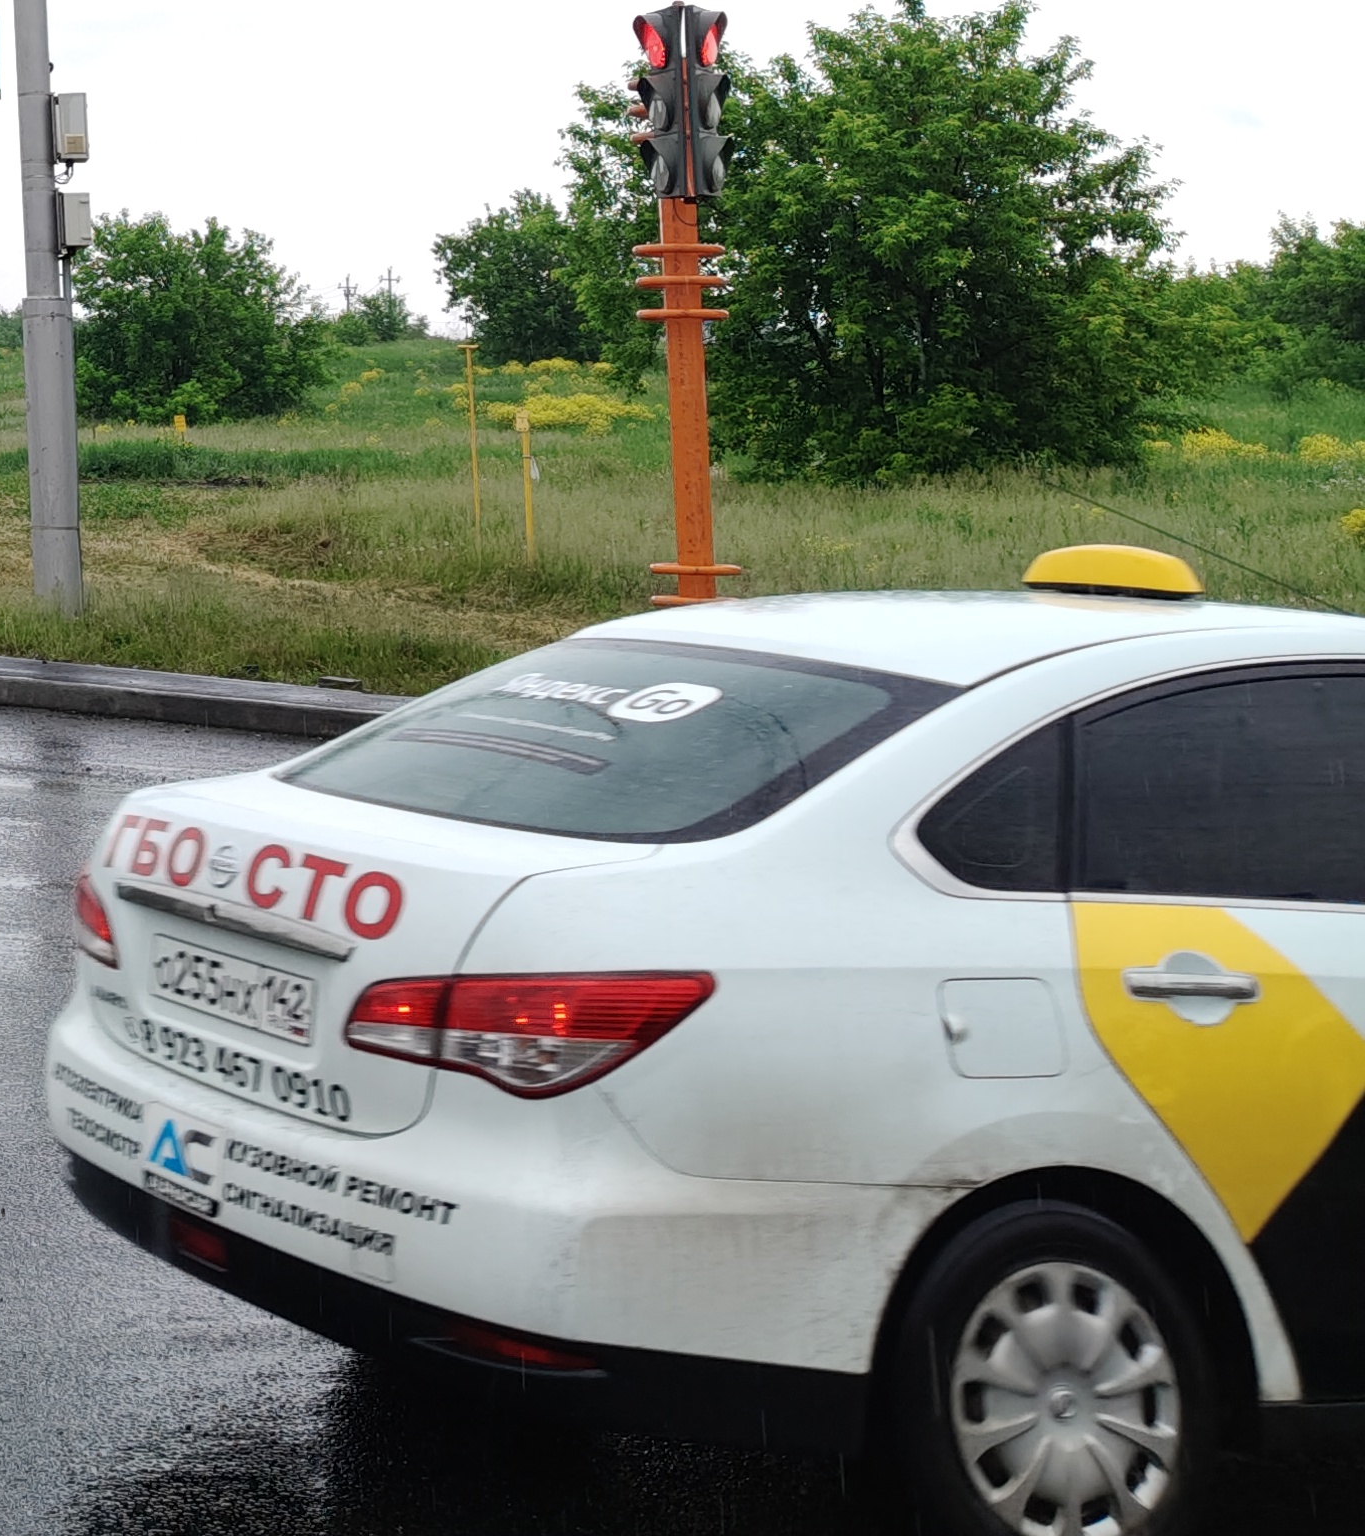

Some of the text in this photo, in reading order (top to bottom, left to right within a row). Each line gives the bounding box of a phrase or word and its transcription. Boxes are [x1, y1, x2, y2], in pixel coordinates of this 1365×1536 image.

[490, 672, 630, 706] Яндекс
[626, 689, 691, 715] Go
[103, 814, 405, 941] ГБО СТО
[139, 1018, 158, 1054] 8
[159, 1025, 210, 1073] 923
[270, 1064, 352, 1122] 0910
[342, 1173, 461, 1225] РЕМОНТ
